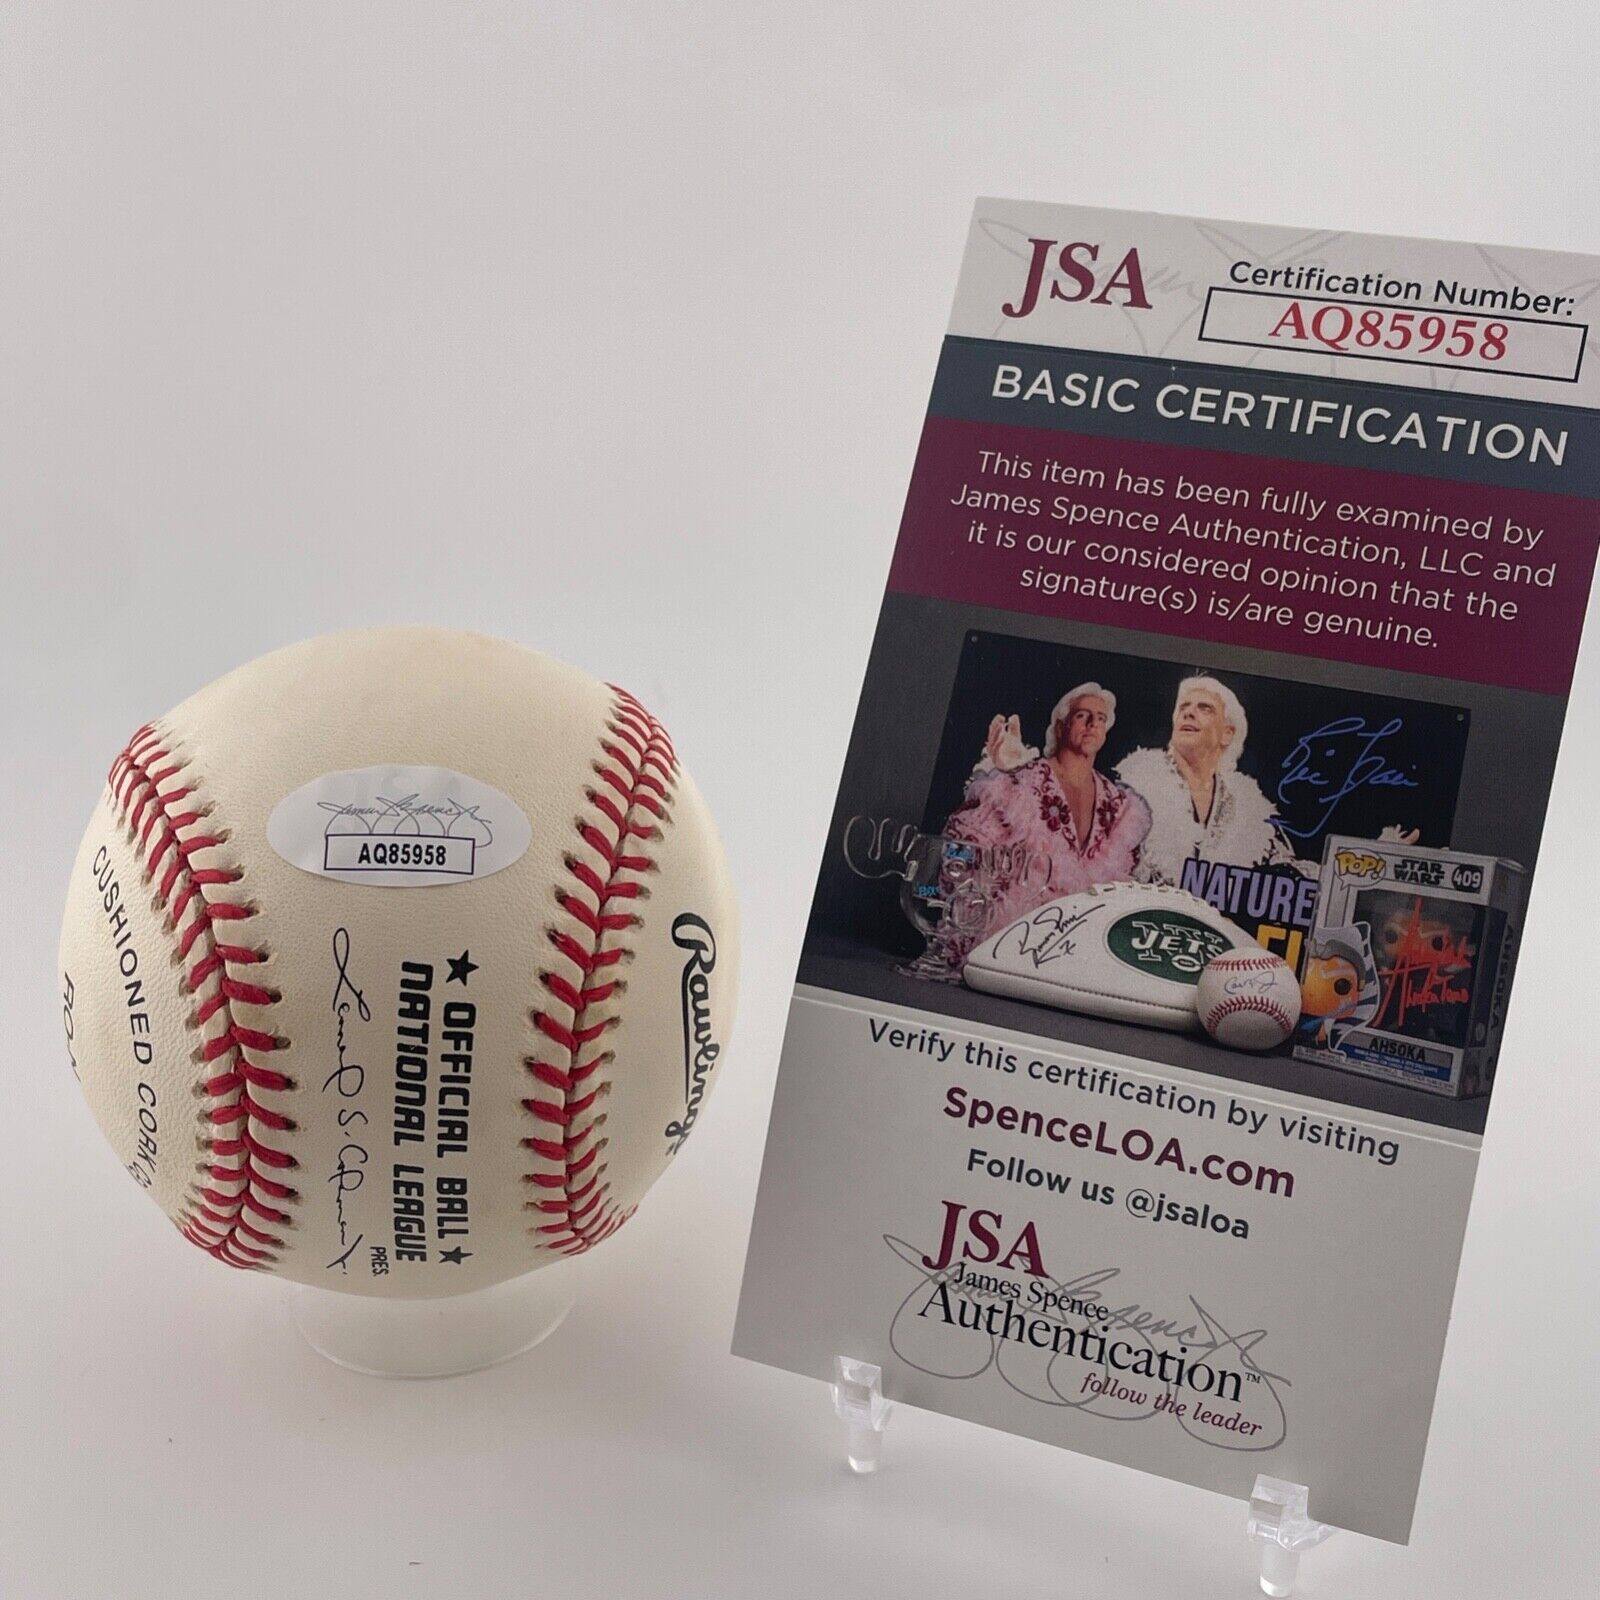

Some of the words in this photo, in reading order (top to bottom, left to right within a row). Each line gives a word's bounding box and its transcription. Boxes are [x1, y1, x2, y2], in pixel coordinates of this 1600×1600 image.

[1002, 238, 1153, 318] JSA
[1229, 260, 1422, 303] Certification
[1433, 281, 1575, 317] Number:
[1269, 302, 1509, 361] AQ85958
[991, 365, 1140, 413] BASIC
[1155, 384, 1568, 466] CERTIFICATION
[951, 484, 1041, 518] James
[1051, 496, 1159, 535] Spence
[1168, 512, 1406, 570] Authentication,
[1419, 548, 1484, 578] LLC
[1492, 558, 1555, 589] and
[978, 450, 1032, 480] This
[1042, 457, 1104, 489] item
[1116, 467, 1164, 498] has
[1176, 477, 1249, 509] been
[1261, 485, 1326, 522] fully
[1336, 499, 1492, 541] examined
[1504, 520, 1544, 551] by
[967, 521, 987, 544] it
[996, 524, 1017, 550] is
[1025, 534, 1076, 558] our
[1084, 538, 1252, 584] considered
[1260, 565, 1380, 603] opinion
[1389, 579, 1453, 612] that
[1465, 592, 1518, 621] the
[1020, 566, 1199, 616] signature(s)
[1208, 591, 1294, 628] is/are
[1304, 609, 1438, 649] genuine.
[358, 843, 446, 866] AQ85958
[1335, 852, 1386, 878] POP!
[1394, 869, 1444, 885] WARS
[1395, 859, 1444, 875] STAR
[1453, 868, 1482, 888] 409
[1181, 858, 1319, 926] NATURE
[1131, 930, 1222, 959] JETS
[93, 845, 152, 1066] CUSHIONED
[137, 1082, 158, 1174] CORK
[394, 961, 434, 1146] NATIONAL
[437, 1001, 476, 1158] OFFICIAL
[1369, 1036, 1426, 1062] AHSOKA
[868, 1019, 957, 1063] Verify
[964, 1041, 1018, 1074] this
[1027, 1055, 1217, 1118] certification
[1227, 1099, 1268, 1133] by
[1279, 1113, 1400, 1166] visiting
[944, 1086, 1295, 1197] SpenceLOA.com
[394, 1163, 427, 1263] LEAGUE
[437, 1176, 469, 1239] BALL
[967, 1149, 1071, 1196] Follow
[1081, 1179, 1115, 1207] us
[1126, 1188, 1250, 1239] @jsaloa
[370, 1246, 389, 1277] PRES.
[922, 1200, 1049, 1279] JSA
[954, 1262, 1021, 1299] James
[1027, 1282, 1109, 1321] Spence
[1080, 1373, 1147, 1405] follow
[1154, 1393, 1187, 1417] the
[1194, 1402, 1263, 1437] leader
